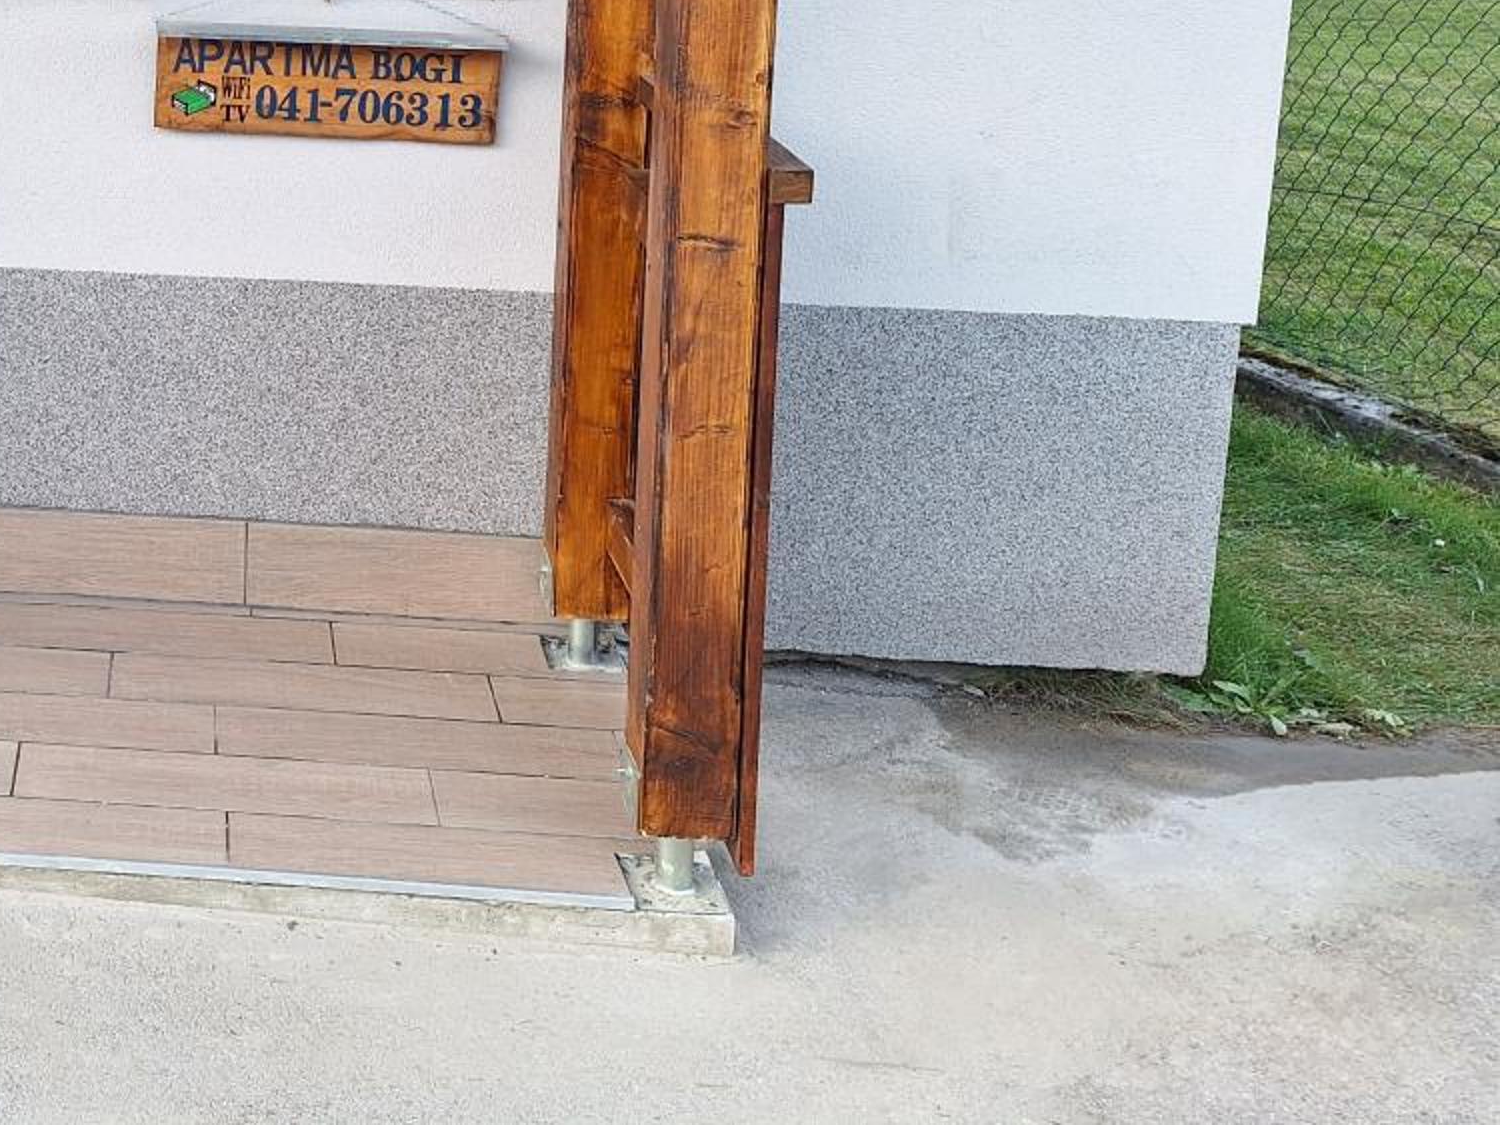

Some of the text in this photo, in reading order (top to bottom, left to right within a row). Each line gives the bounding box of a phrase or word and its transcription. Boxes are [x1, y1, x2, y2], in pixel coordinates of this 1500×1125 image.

[173, 38, 464, 84] APARTMA BOGI
[219, 104, 251, 123] TV
[255, 84, 483, 129] 041-706313
